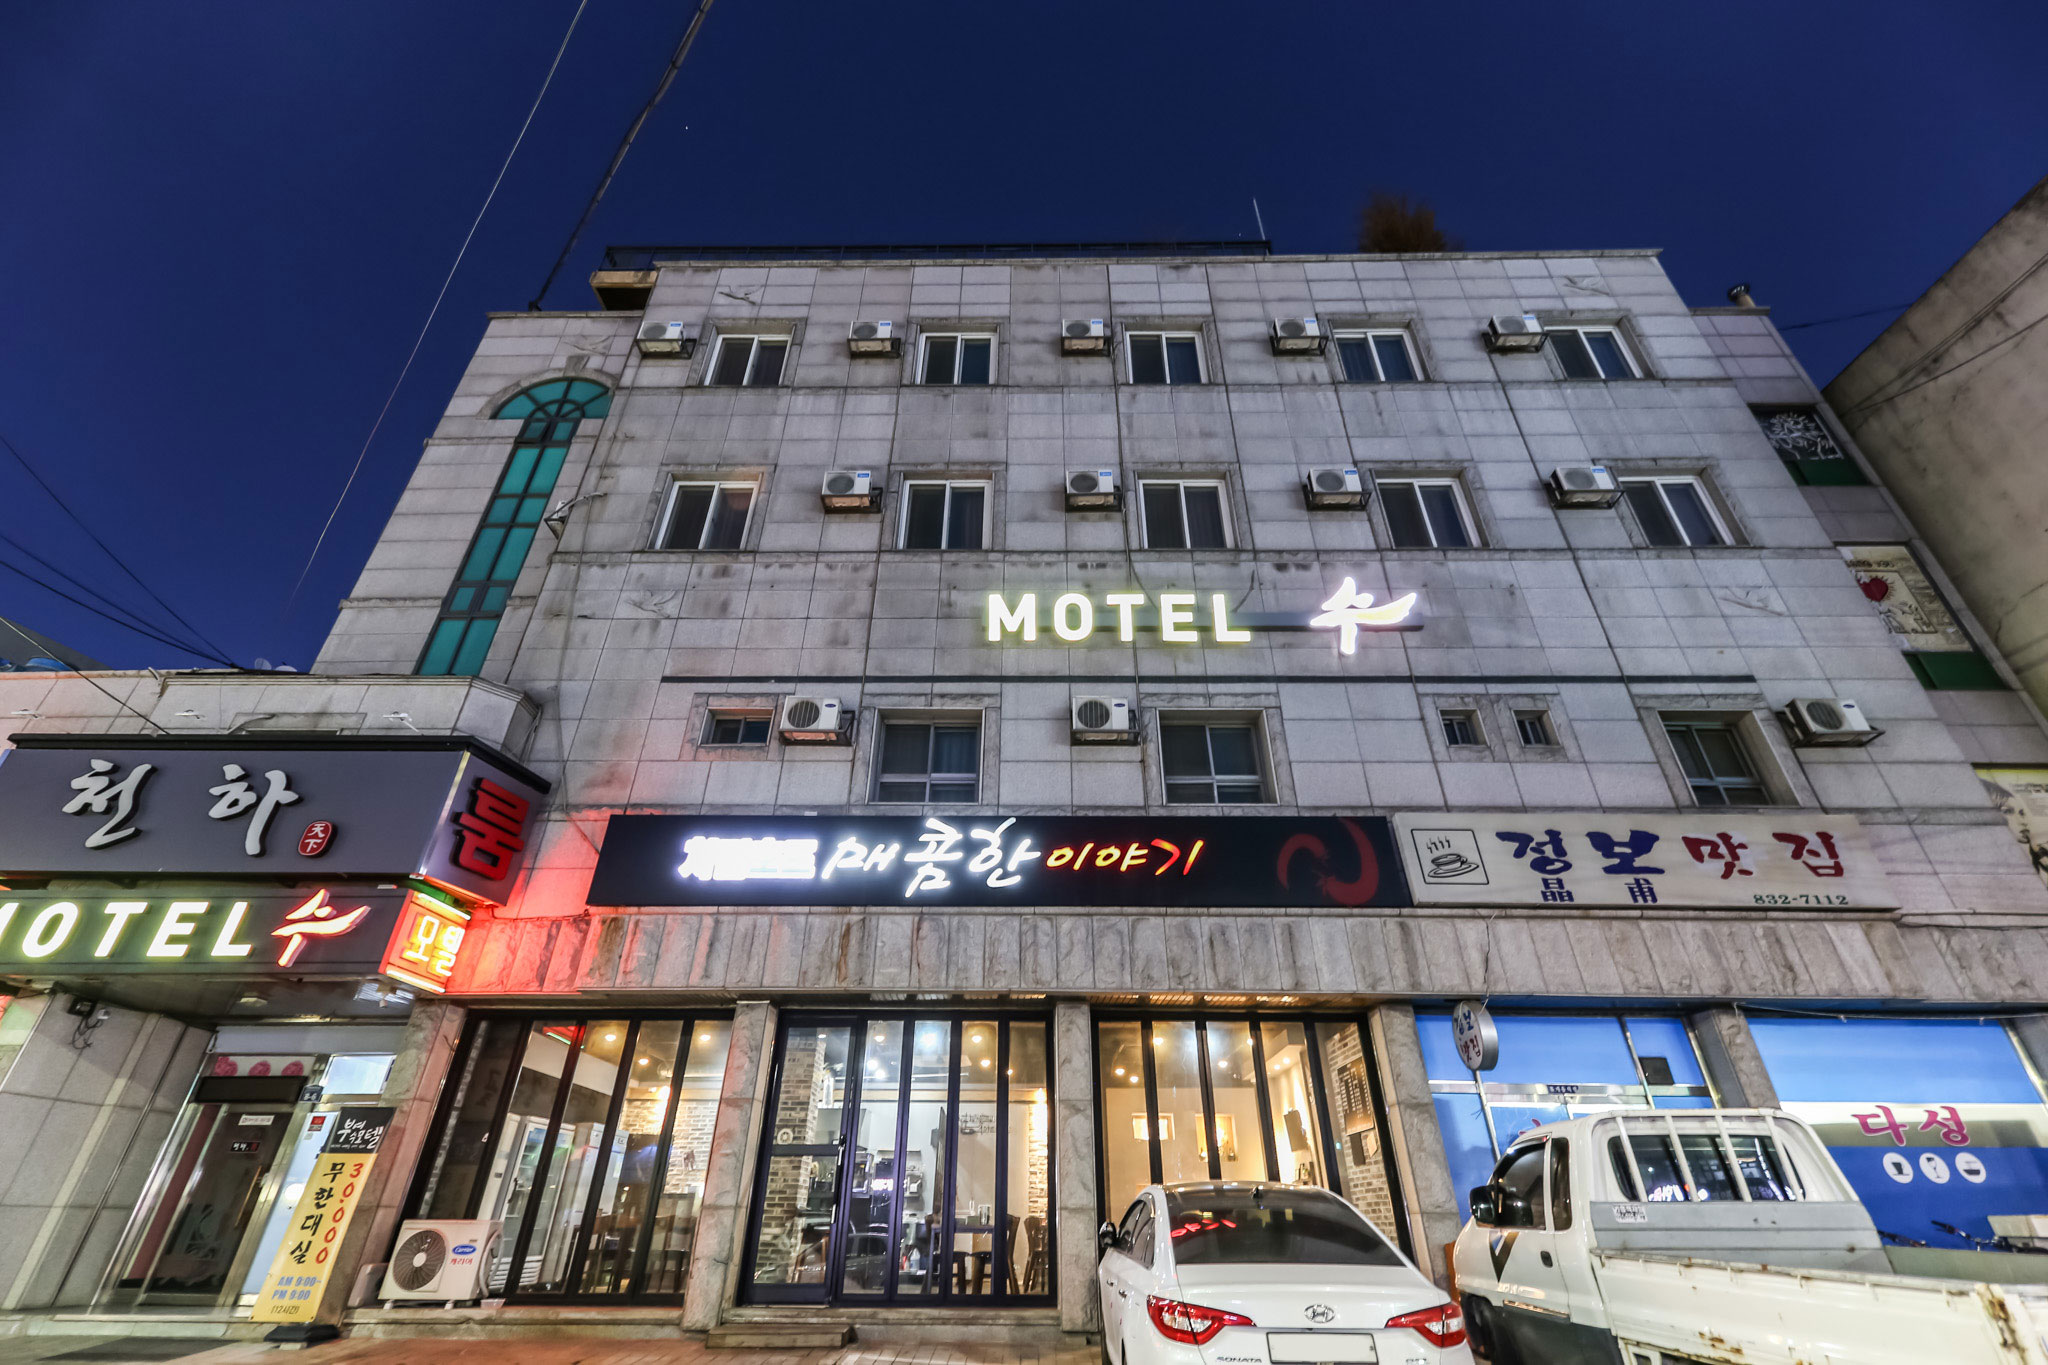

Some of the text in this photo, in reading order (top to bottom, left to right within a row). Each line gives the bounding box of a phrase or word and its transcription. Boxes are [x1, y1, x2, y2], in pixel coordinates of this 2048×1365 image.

[987, 592, 1252, 643] MOTEL
[62, 758, 299, 857] 천하
[458, 777, 530, 881] 룸
[303, 823, 326, 853] 天下
[1045, 837, 1205, 878] 이야기
[1495, 829, 1844, 880] 정보 맛집
[1753, 894, 1849, 905] 832-7112
[405, 914, 466, 977] 모텔
[1850, 1104, 1971, 1147] 다성
[289, 1162, 346, 1265] 무한대실
[271, 1289, 312, 1300] PM 9:00
[277, 1276, 295, 1287] AM
[1216, 1356, 1263, 1364] SONATA
